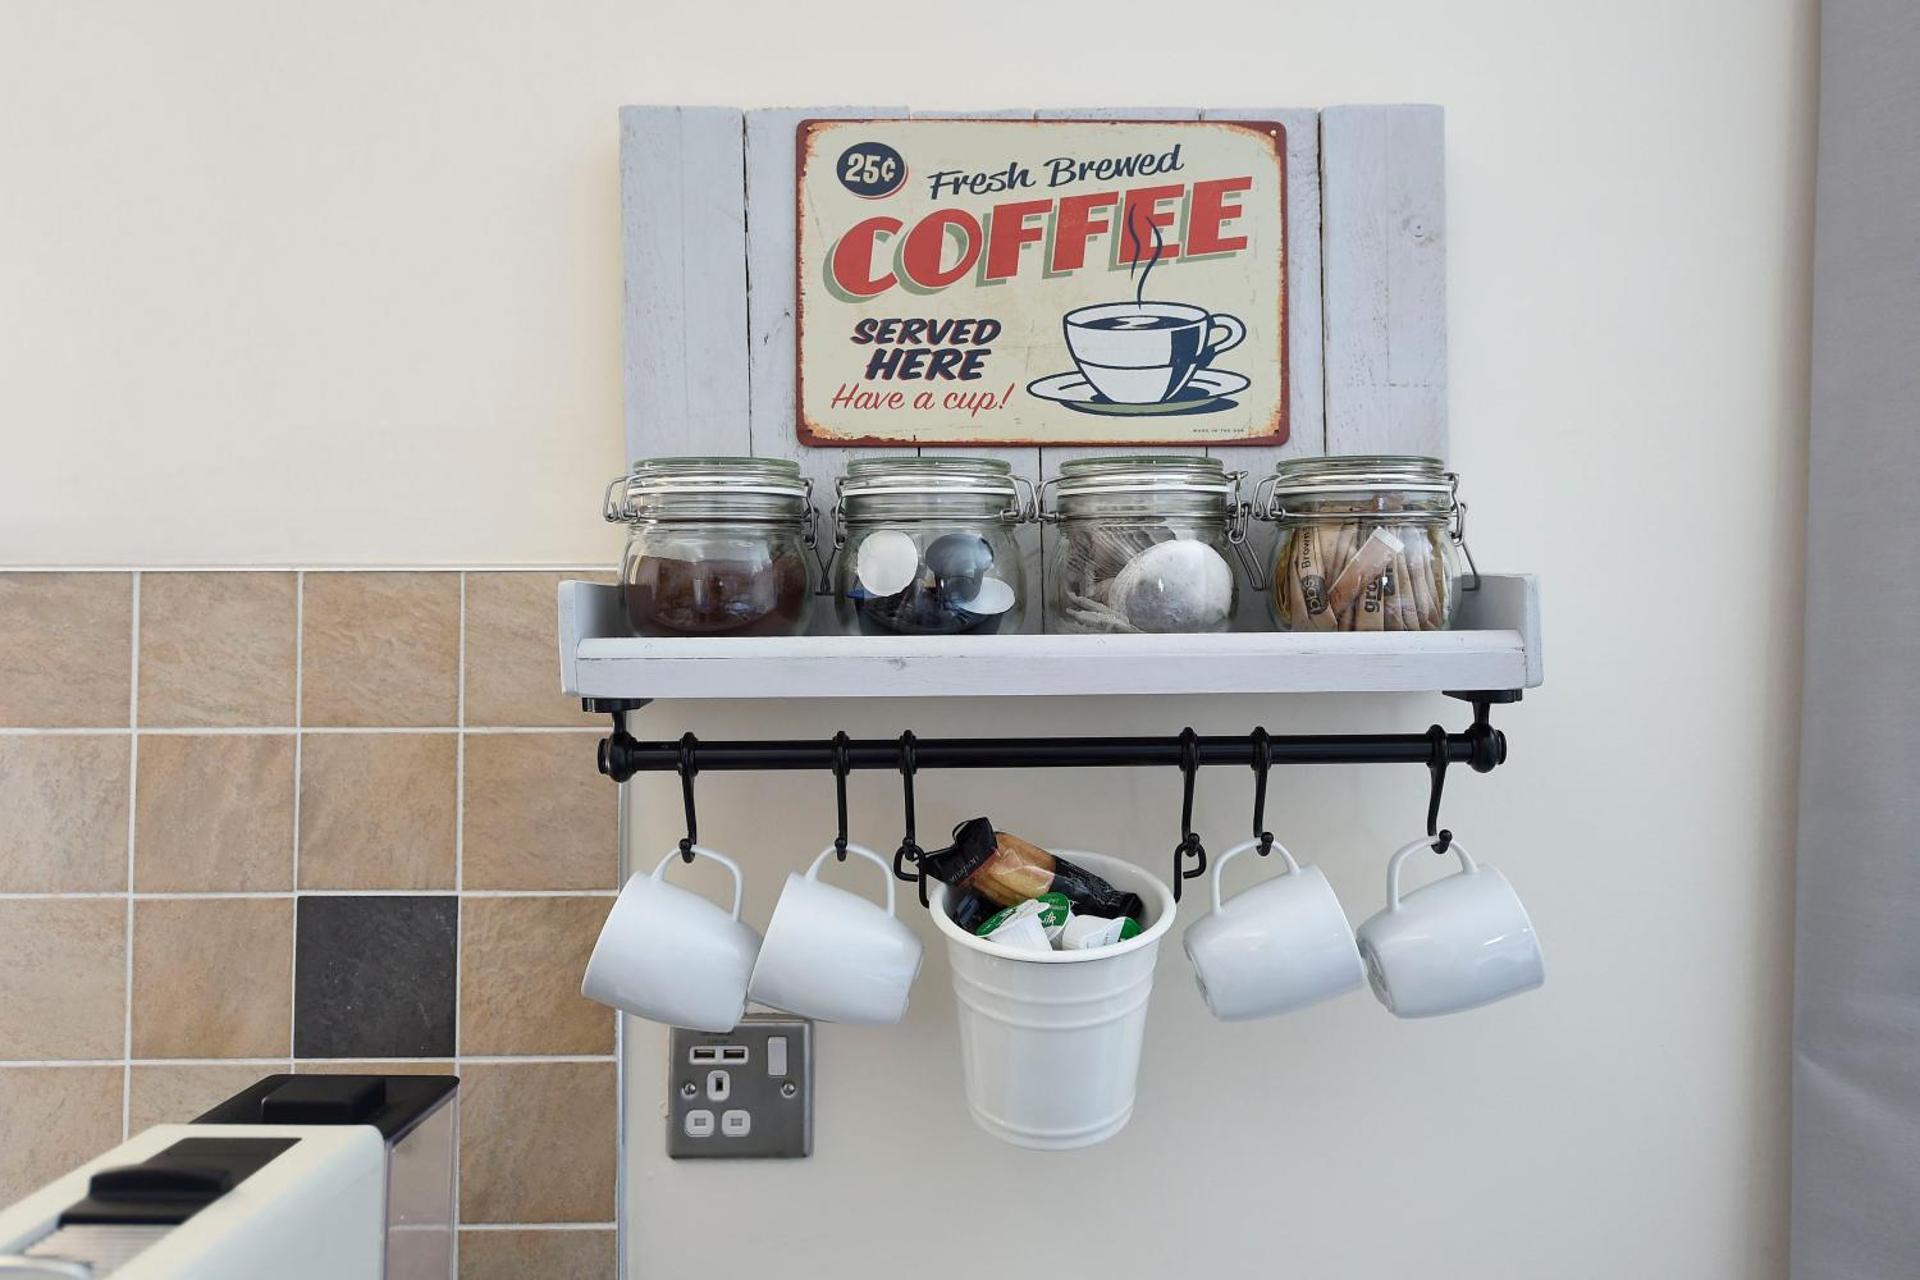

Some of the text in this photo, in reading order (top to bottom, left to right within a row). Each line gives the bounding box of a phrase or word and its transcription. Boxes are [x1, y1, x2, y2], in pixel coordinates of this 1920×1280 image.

[845, 152, 896, 185] 25¢
[927, 144, 1184, 200] Fresh Brewed
[823, 176, 1252, 303] COFFEE
[850, 318, 1002, 345] SERVED
[864, 347, 992, 381] HERE
[831, 382, 1015, 418] Have a cup!
